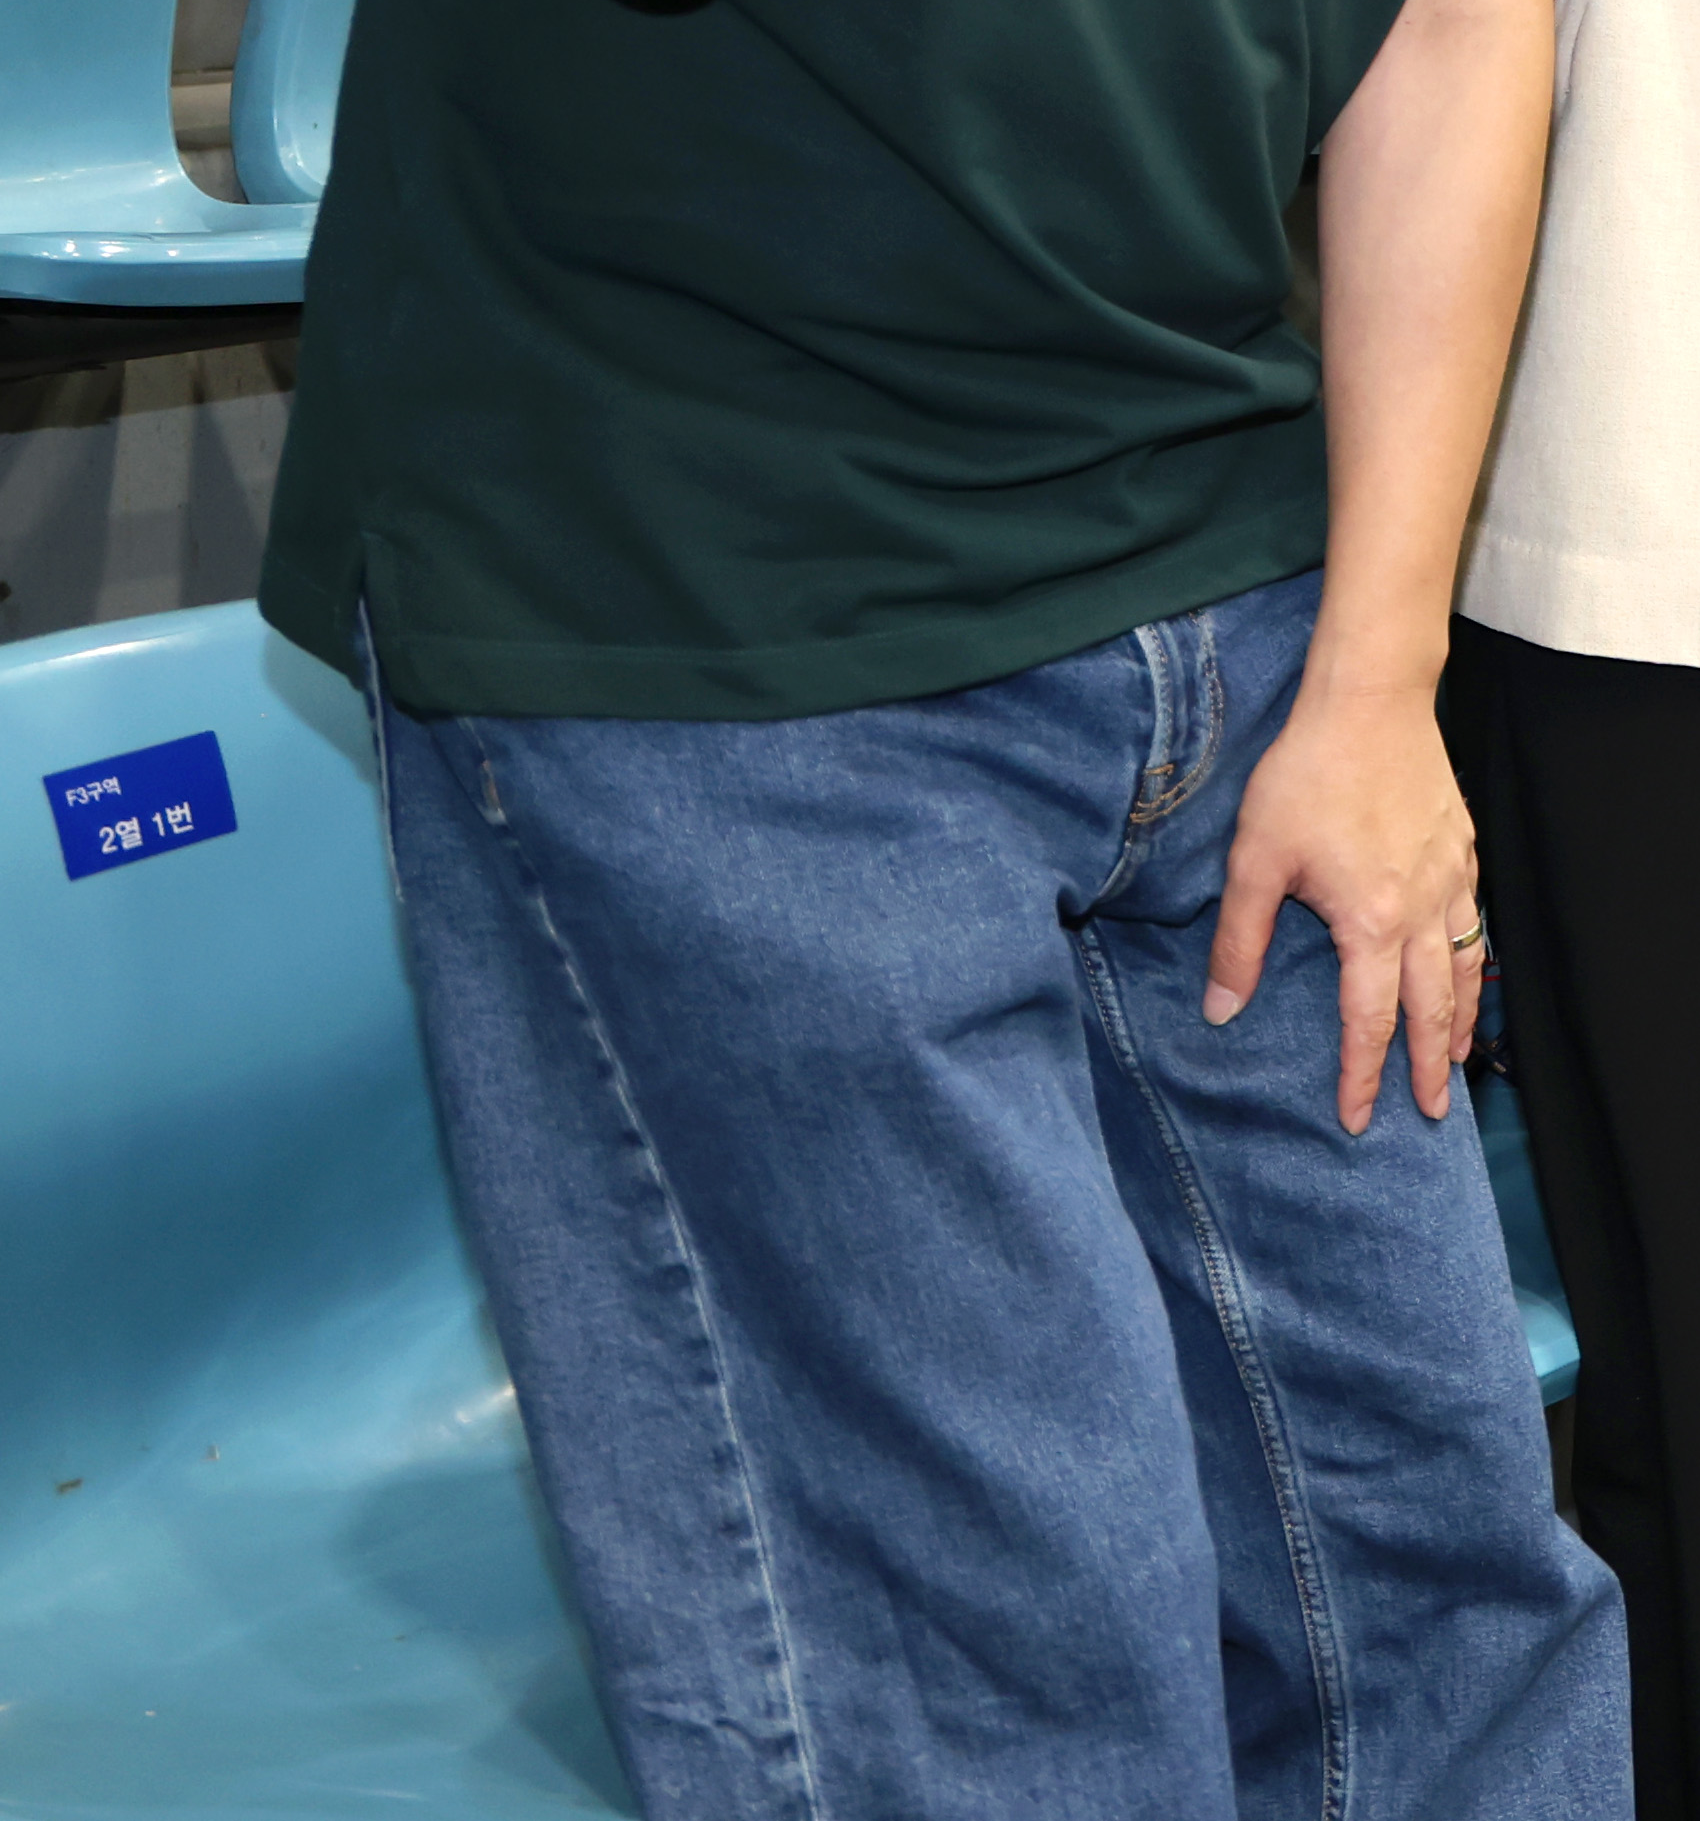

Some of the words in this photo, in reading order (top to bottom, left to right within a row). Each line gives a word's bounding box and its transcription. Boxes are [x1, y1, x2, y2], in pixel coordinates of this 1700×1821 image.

[65, 776, 122, 808] F3구역
[99, 816, 144, 855] 2열
[152, 801, 195, 837] 1번
